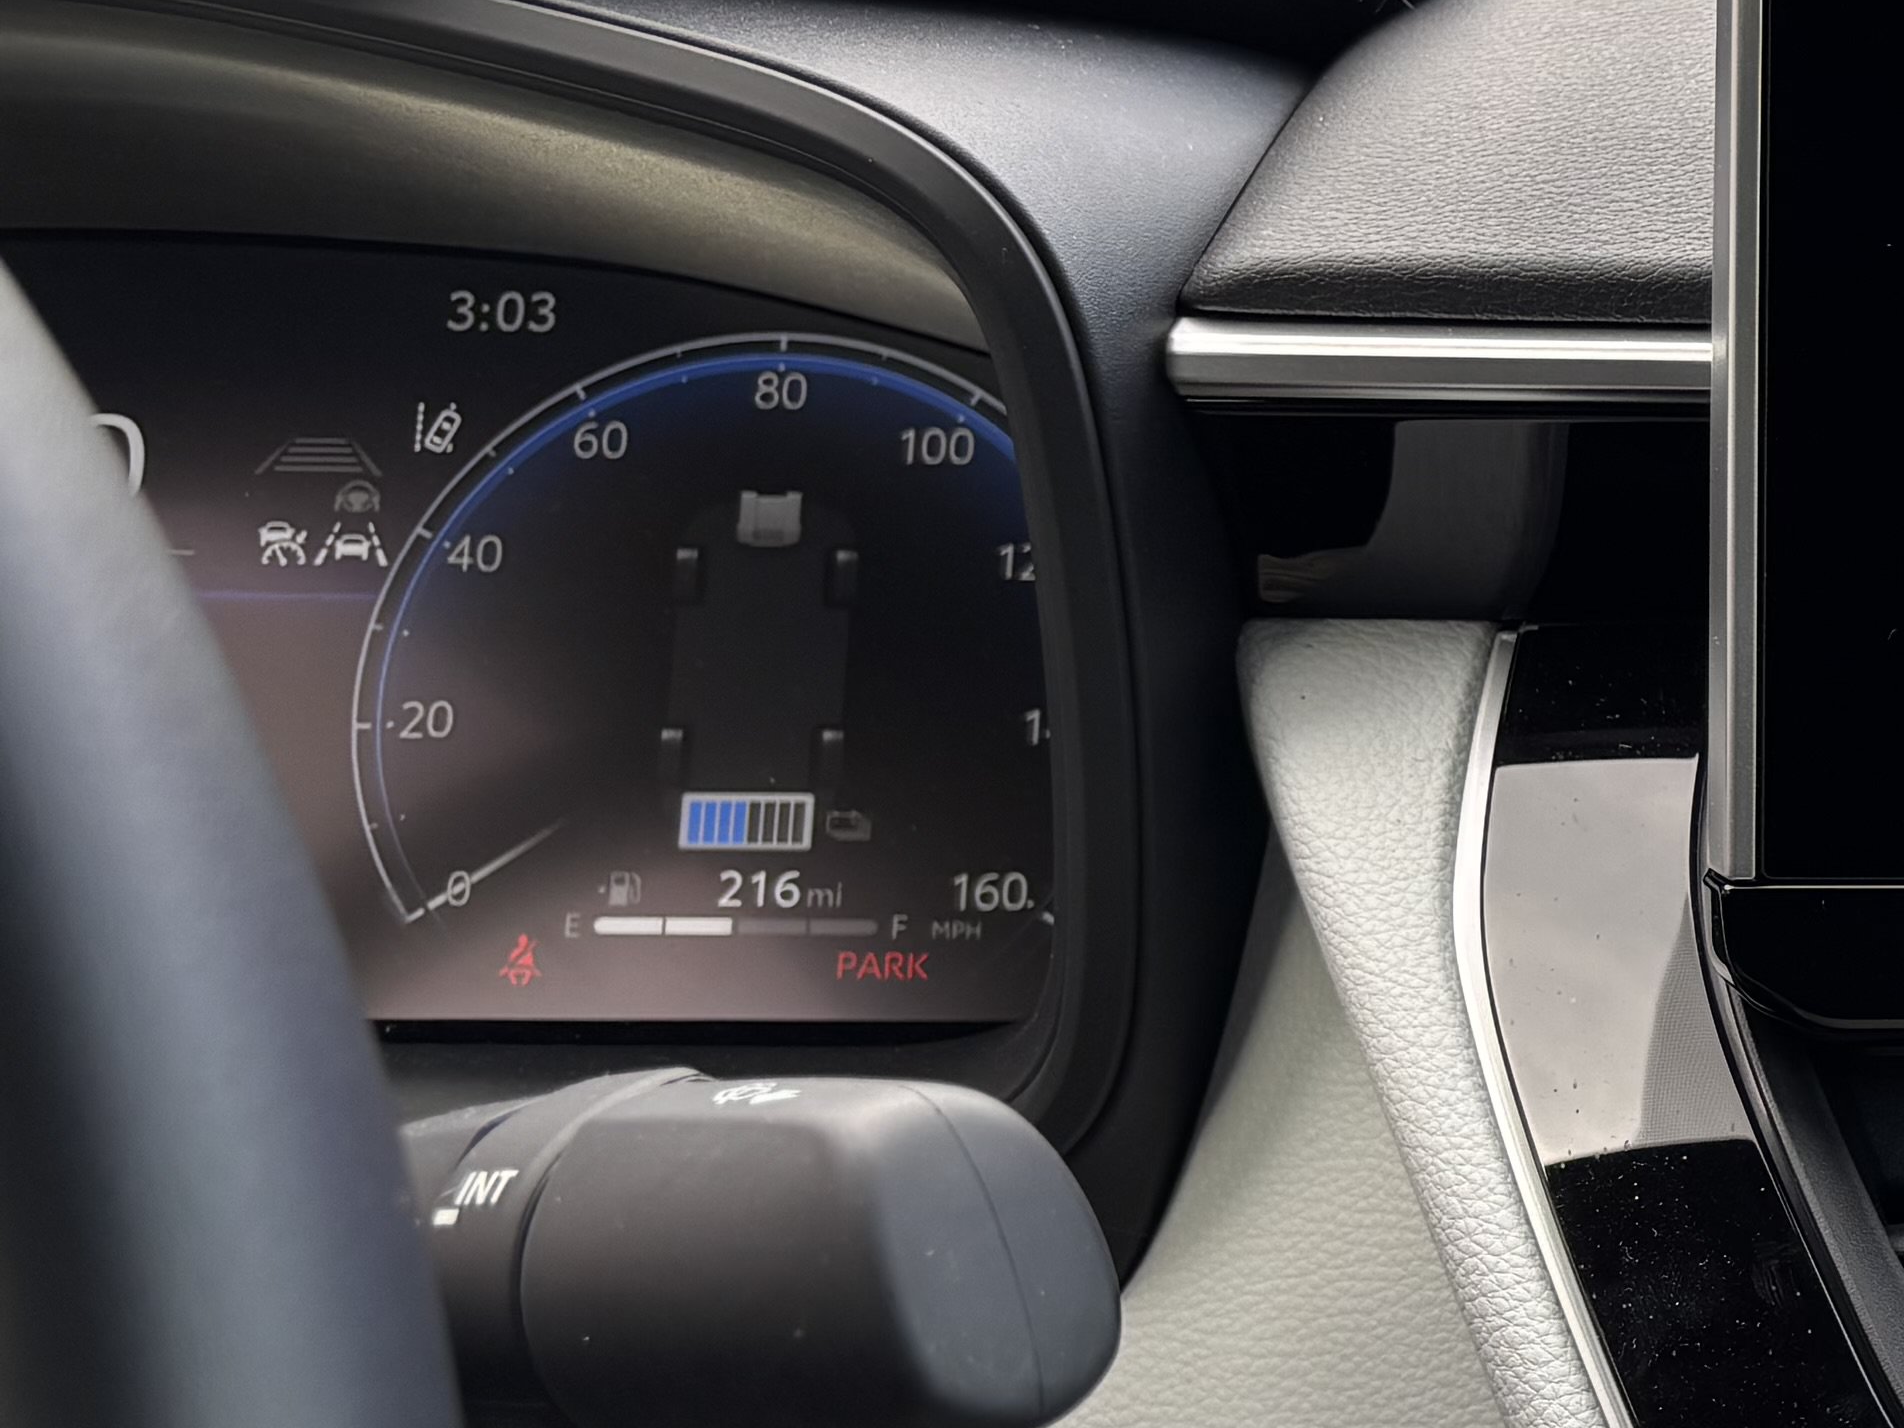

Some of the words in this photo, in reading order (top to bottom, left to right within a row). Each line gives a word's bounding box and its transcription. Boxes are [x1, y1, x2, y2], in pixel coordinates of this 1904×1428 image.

[446, 290, 557, 333] 3:03
[754, 371, 807, 411] 80
[572, 421, 629, 460] 60
[899, 427, 975, 465] 100
[447, 534, 504, 573] 40
[399, 700, 455, 739] 20
[446, 869, 472, 906] 0
[716, 869, 801, 908] 216
[806, 880, 842, 908] mi
[953, 871, 1028, 912] 160
[564, 913, 581, 940] E
[891, 914, 908, 940] F
[930, 919, 983, 941] MPH
[835, 951, 930, 980] PARK
[455, 1169, 519, 1206] INT
